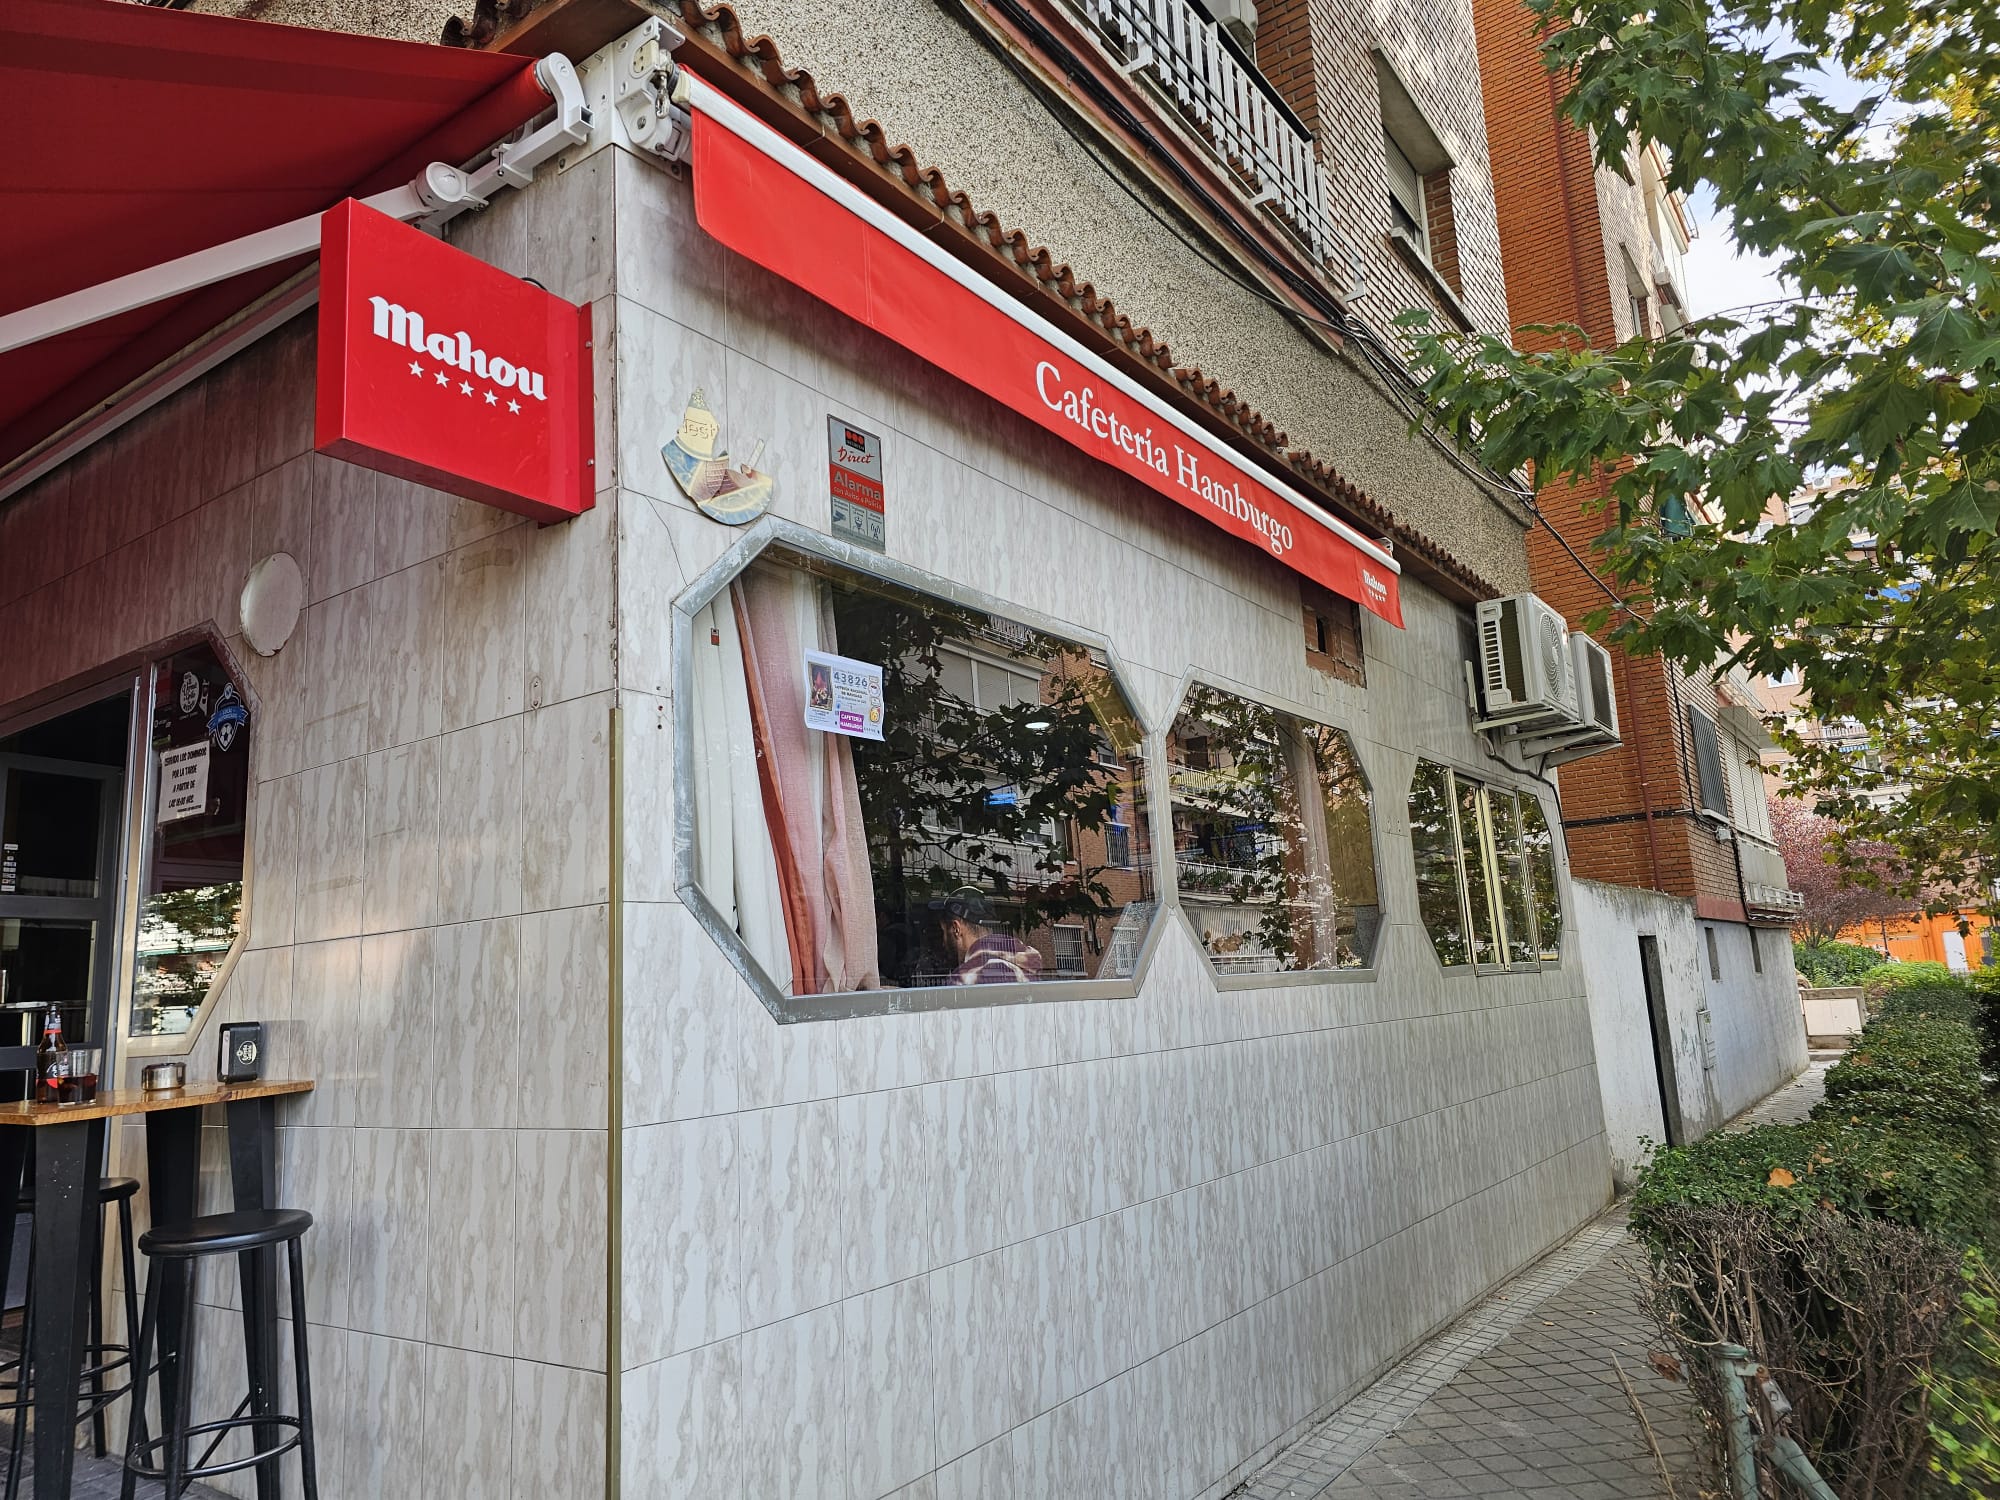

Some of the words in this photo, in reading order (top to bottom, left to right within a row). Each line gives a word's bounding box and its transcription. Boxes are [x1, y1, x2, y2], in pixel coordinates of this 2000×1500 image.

[837, 446, 875, 464] Direct
[1036, 361, 1170, 477] Cafetería
[1174, 445, 1293, 554] Hamburgo
[834, 470, 881, 500] Alarma
[833, 671, 868, 687] 43826
[179, 768, 185, 777] LA
[185, 764, 198, 776] TARDE
[190, 779, 196, 789] DE
